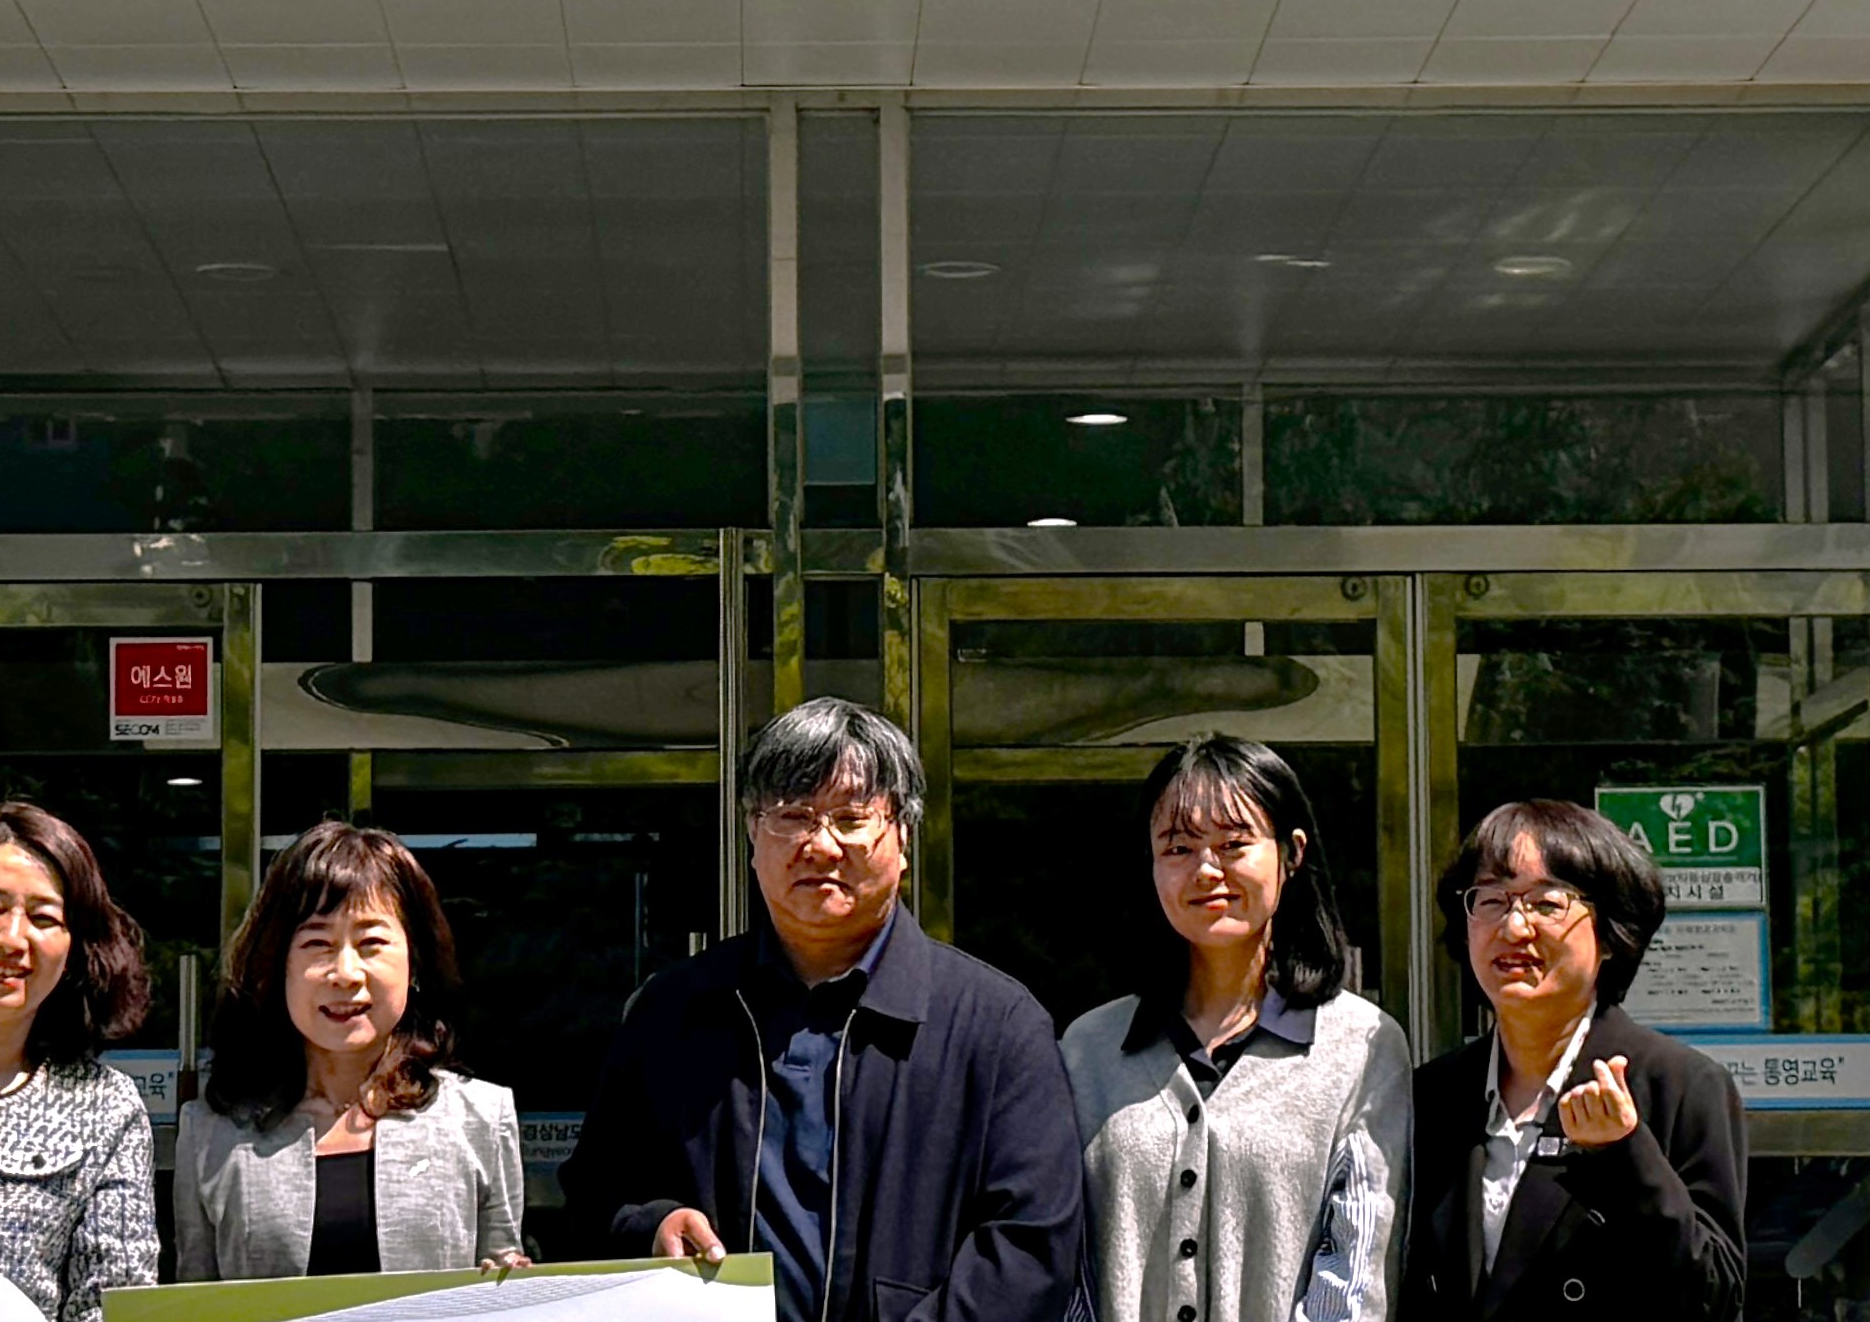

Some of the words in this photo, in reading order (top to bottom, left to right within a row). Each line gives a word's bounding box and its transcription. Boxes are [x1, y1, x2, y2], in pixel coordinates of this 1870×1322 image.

[131, 664, 192, 689] 에스원
[115, 724, 160, 736] SECOM
[1629, 821, 1739, 853] AED
[1764, 1057, 1845, 1086] 통영교육"
